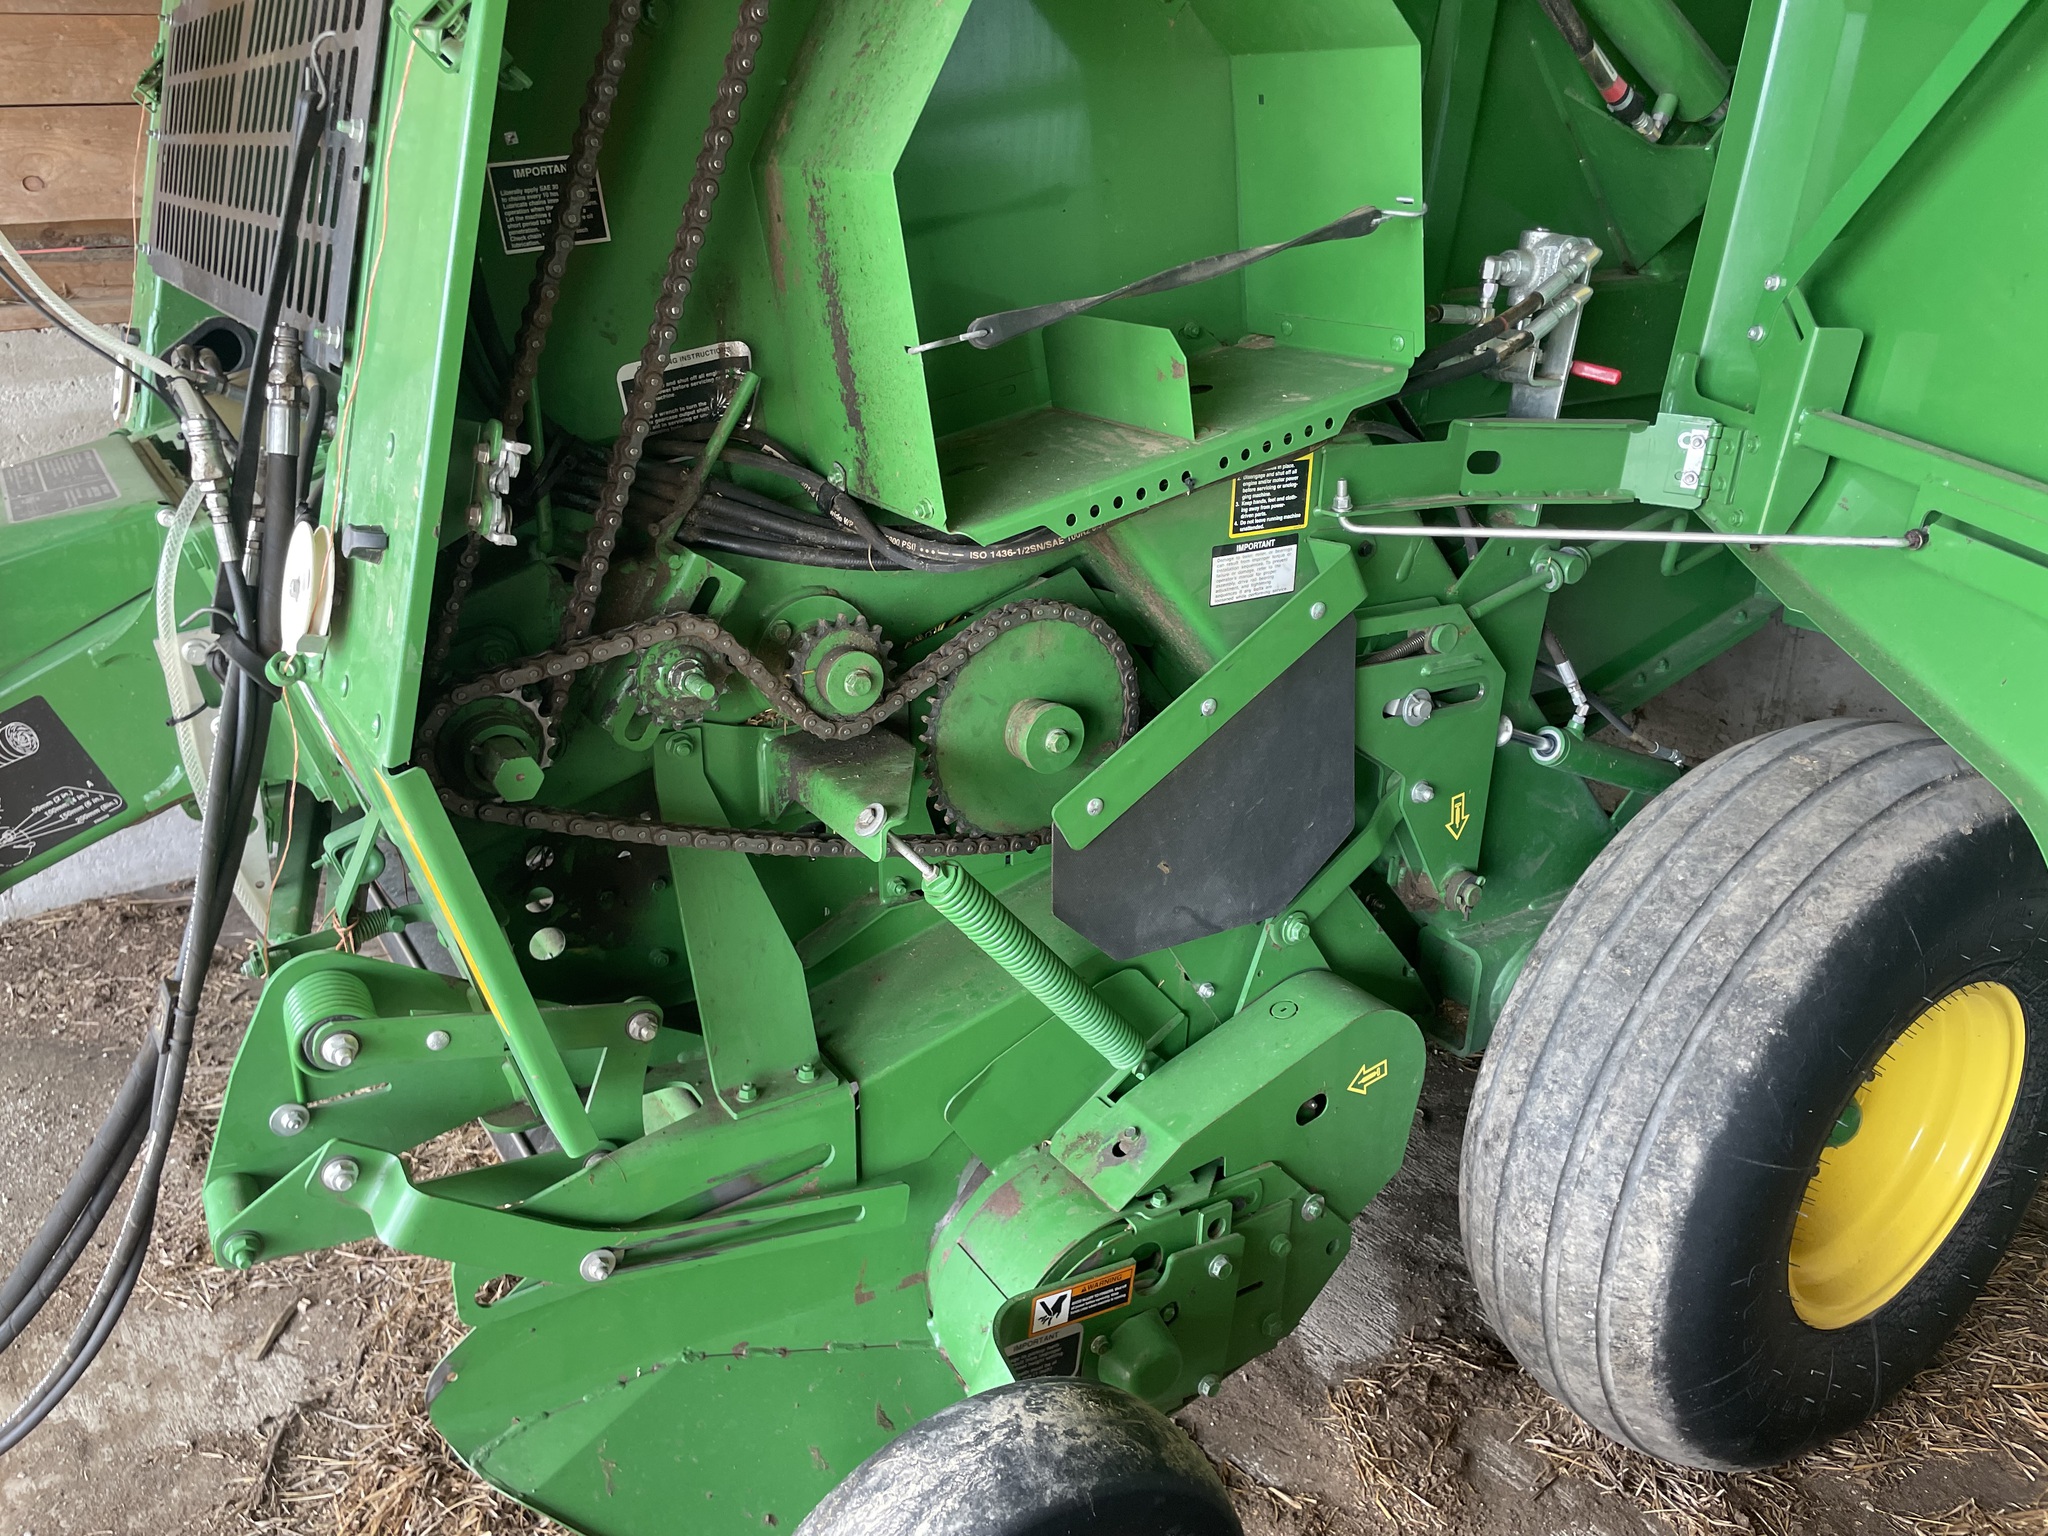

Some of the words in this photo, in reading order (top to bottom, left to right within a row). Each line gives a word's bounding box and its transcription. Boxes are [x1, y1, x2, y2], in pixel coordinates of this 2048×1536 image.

[512, 163, 567, 179] IMPORTAN
[656, 386, 671, 395] ower
[672, 382, 689, 391] before
[690, 377, 715, 387] servicing
[655, 393, 675, 401] achine.
[1283, 512, 1301, 520] machine
[969, 551, 987, 559] ISO
[990, 537, 1065, 558] 1436-1/2SN/SAE
[1236, 539, 1276, 552] IMPORTANT
[86, 779, 94, 789] A
[31, 800, 53, 814] 50mm
[44, 802, 70, 817] 100mm
[59, 805, 84, 820] 150mm
[1087, 1274, 1122, 1290] WARNING
[1013, 1331, 1060, 1352] IMPORTANT
